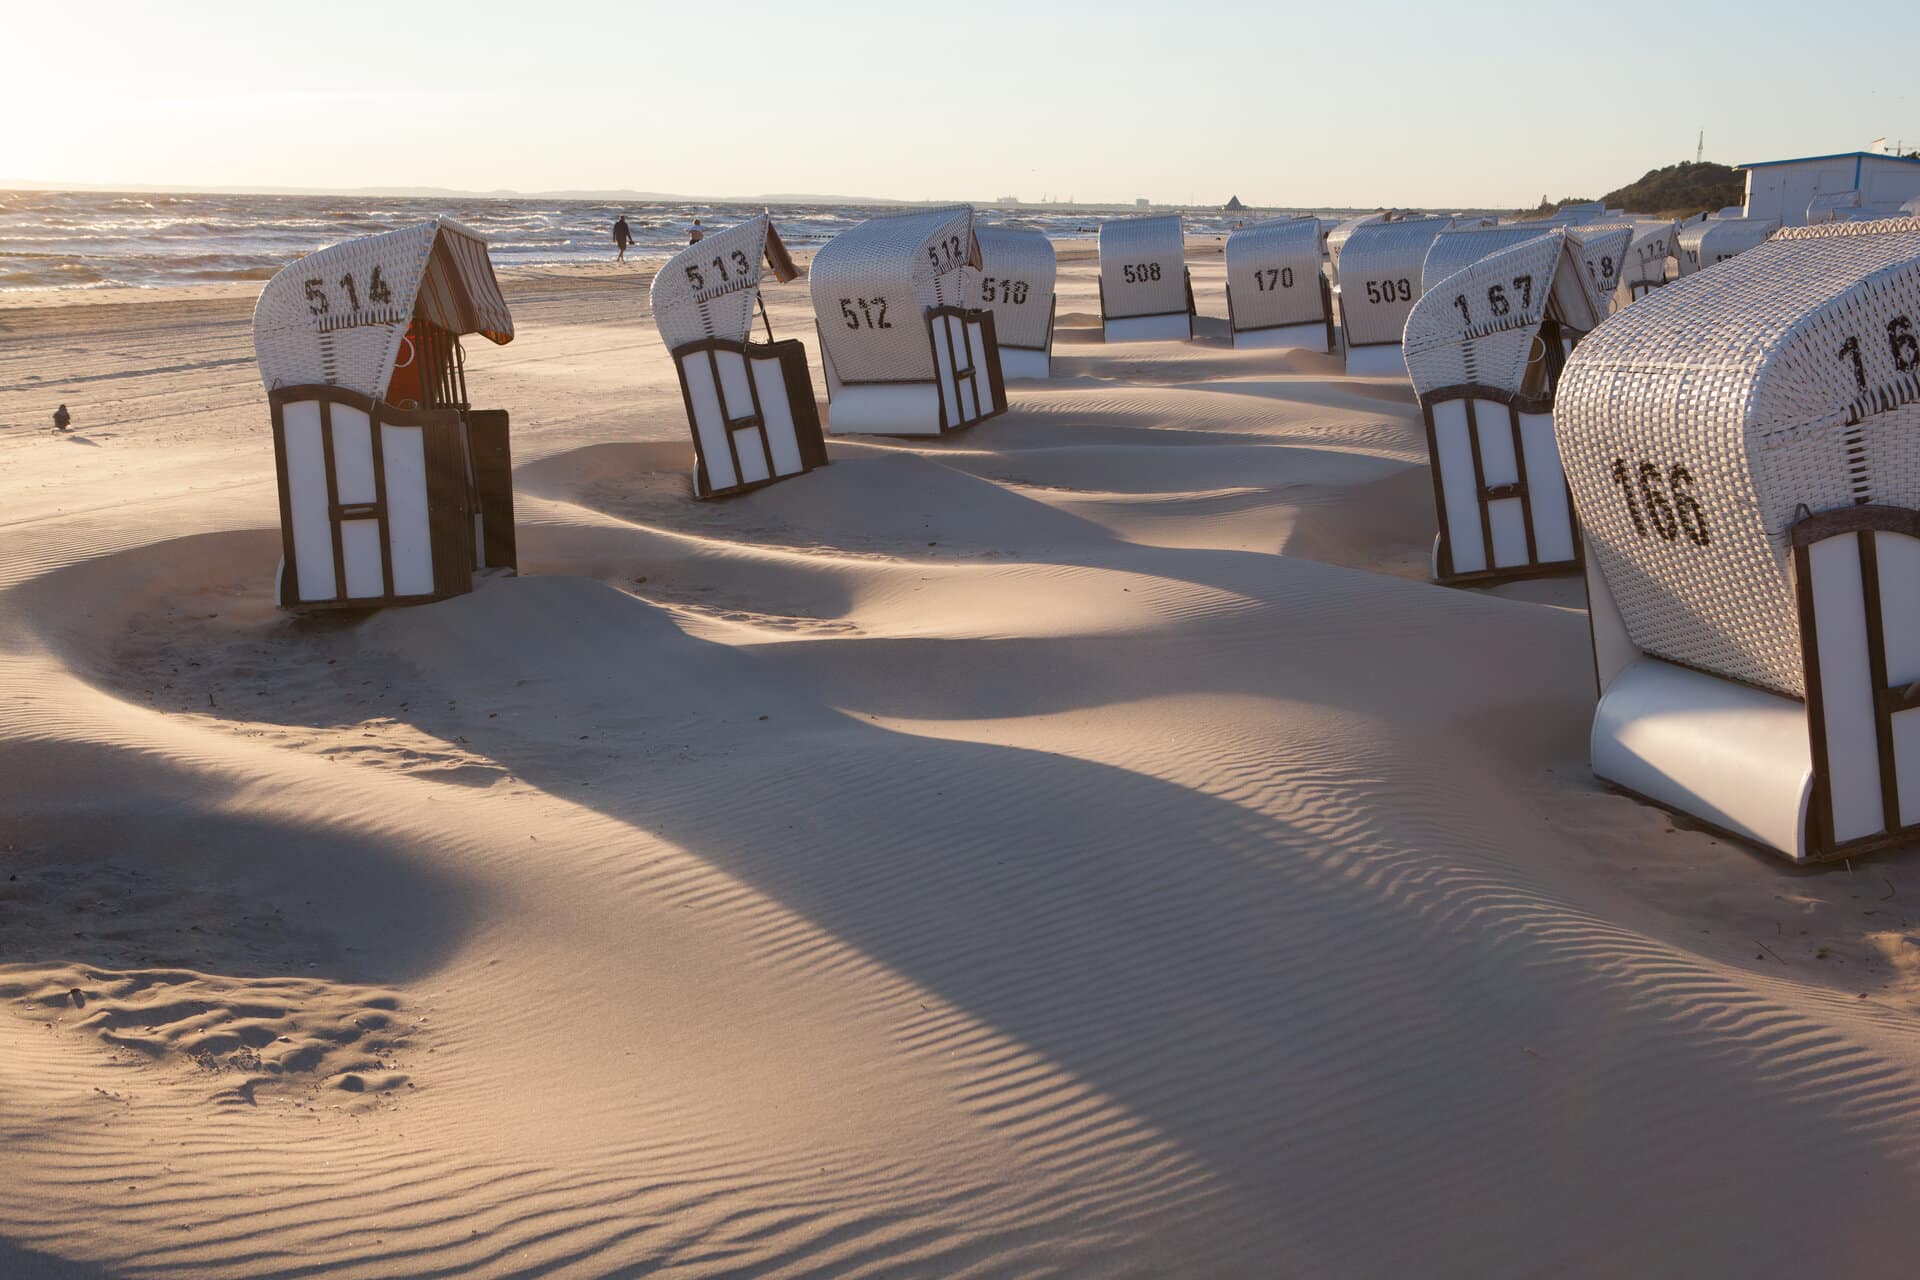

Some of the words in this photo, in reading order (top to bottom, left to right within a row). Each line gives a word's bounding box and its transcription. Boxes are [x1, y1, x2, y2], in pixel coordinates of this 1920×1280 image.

[928, 236, 962, 267] 512
[1124, 253, 1161, 283] 508
[685, 250, 749, 290] 513
[1255, 257, 1294, 291] 170
[305, 265, 391, 315] 514
[982, 277, 1029, 304] 510
[1366, 278, 1411, 304] 509
[1454, 274, 1531, 325] 167
[840, 297, 892, 330] 512
[1611, 458, 1709, 546] 166
